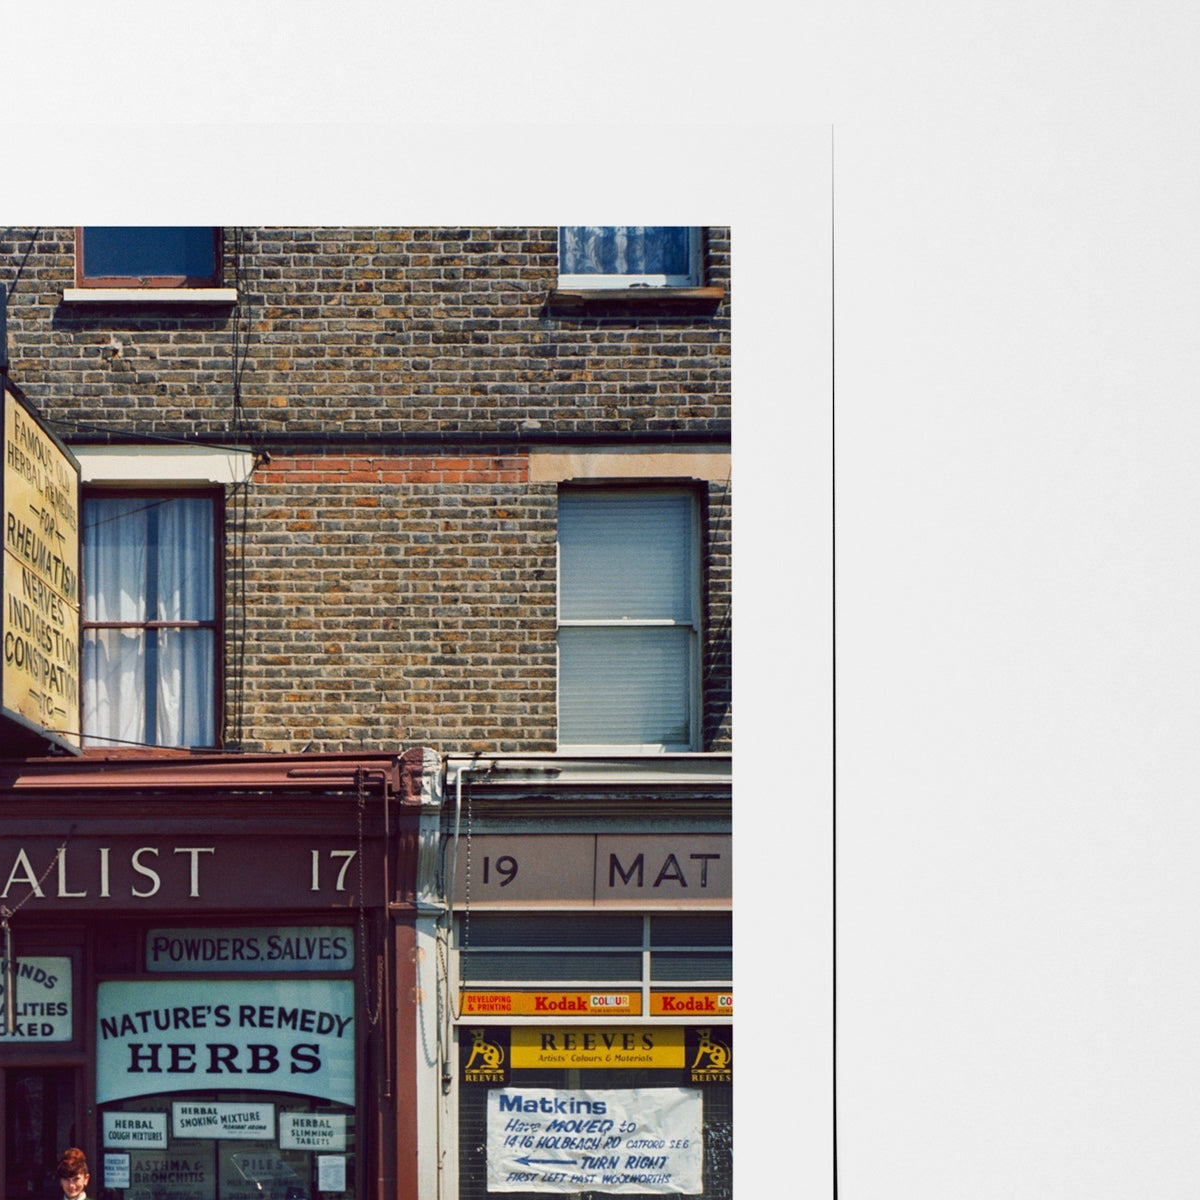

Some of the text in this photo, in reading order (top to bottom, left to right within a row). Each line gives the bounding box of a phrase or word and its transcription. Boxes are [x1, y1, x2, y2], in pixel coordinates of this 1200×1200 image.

[14, 409, 53, 473] FAMOUS
[7, 440, 43, 494] HERBAL
[40, 507, 55, 538] FOR
[7, 511, 76, 599] RHEUMATISM
[22, 567, 64, 626] NERVES
[8, 593, 76, 671] INDIGESTION
[5, 631, 76, 704] CONSTIPATION
[311, 850, 358, 891] 17
[482, 856, 519, 887] 19
[609, 853, 720, 887] MAT
[267, 935, 347, 960] SALVES
[467, 995, 511, 1003] DEVELOPING
[535, 996, 628, 1011] Kodak COLOUR
[662, 996, 715, 1011] Kodak
[100, 1004, 353, 1040] NATURE'S REMEDY
[540, 1033, 654, 1051] REEVES
[127, 1043, 322, 1074] HERBS
[571, 1054, 602, 1062] Colours
[615, 1054, 653, 1062] Materials
[465, 1074, 504, 1082] REEVES
[691, 1074, 731, 1082] REEVES
[182, 1107, 218, 1115] HERBAL
[499, 1094, 607, 1115] Matkins
[115, 1120, 154, 1129] HERBAL
[180, 1111, 260, 1128] SMOKING MIXTURE
[292, 1119, 331, 1128] HERBAL
[505, 1118, 636, 1133] Have MOVED to
[108, 1131, 162, 1141] COUGH MIXTURES
[536, 1136, 599, 1150] HOLBEACH
[603, 1136, 621, 1149] RD
[626, 1139, 665, 1149] CATFORD
[135, 1159, 190, 1171] ASTHMA
[243, 1159, 284, 1170] PILES
[581, 1156, 668, 1170] TURN RIGHT
[134, 1172, 205, 1183] BRONCHITIS
[506, 1172, 671, 1184] FIRST LEFT PAST WOOLWORTHS
